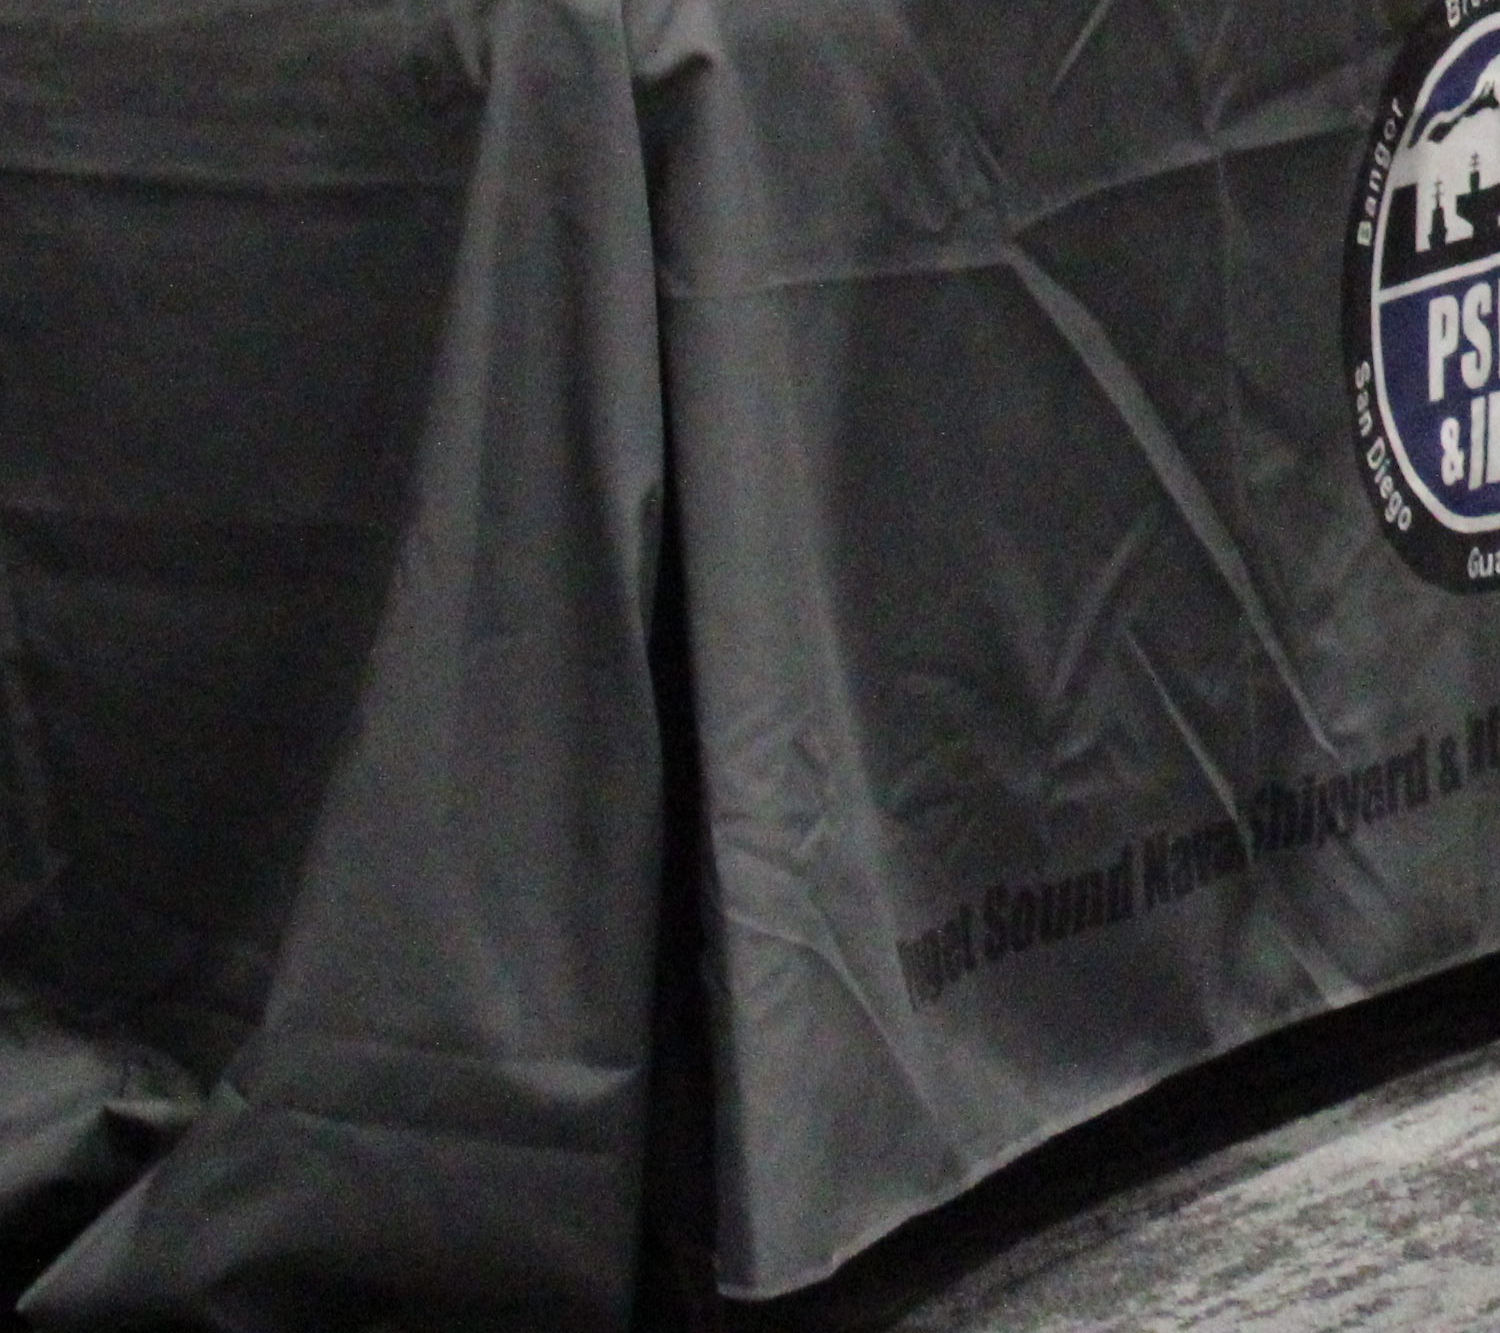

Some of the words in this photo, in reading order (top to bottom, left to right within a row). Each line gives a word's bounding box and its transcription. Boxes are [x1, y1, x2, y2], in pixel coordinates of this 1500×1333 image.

[1354, 361, 1373, 436] San
[1366, 436, 1412, 531] Diego
[1440, 417, 1464, 486] &
